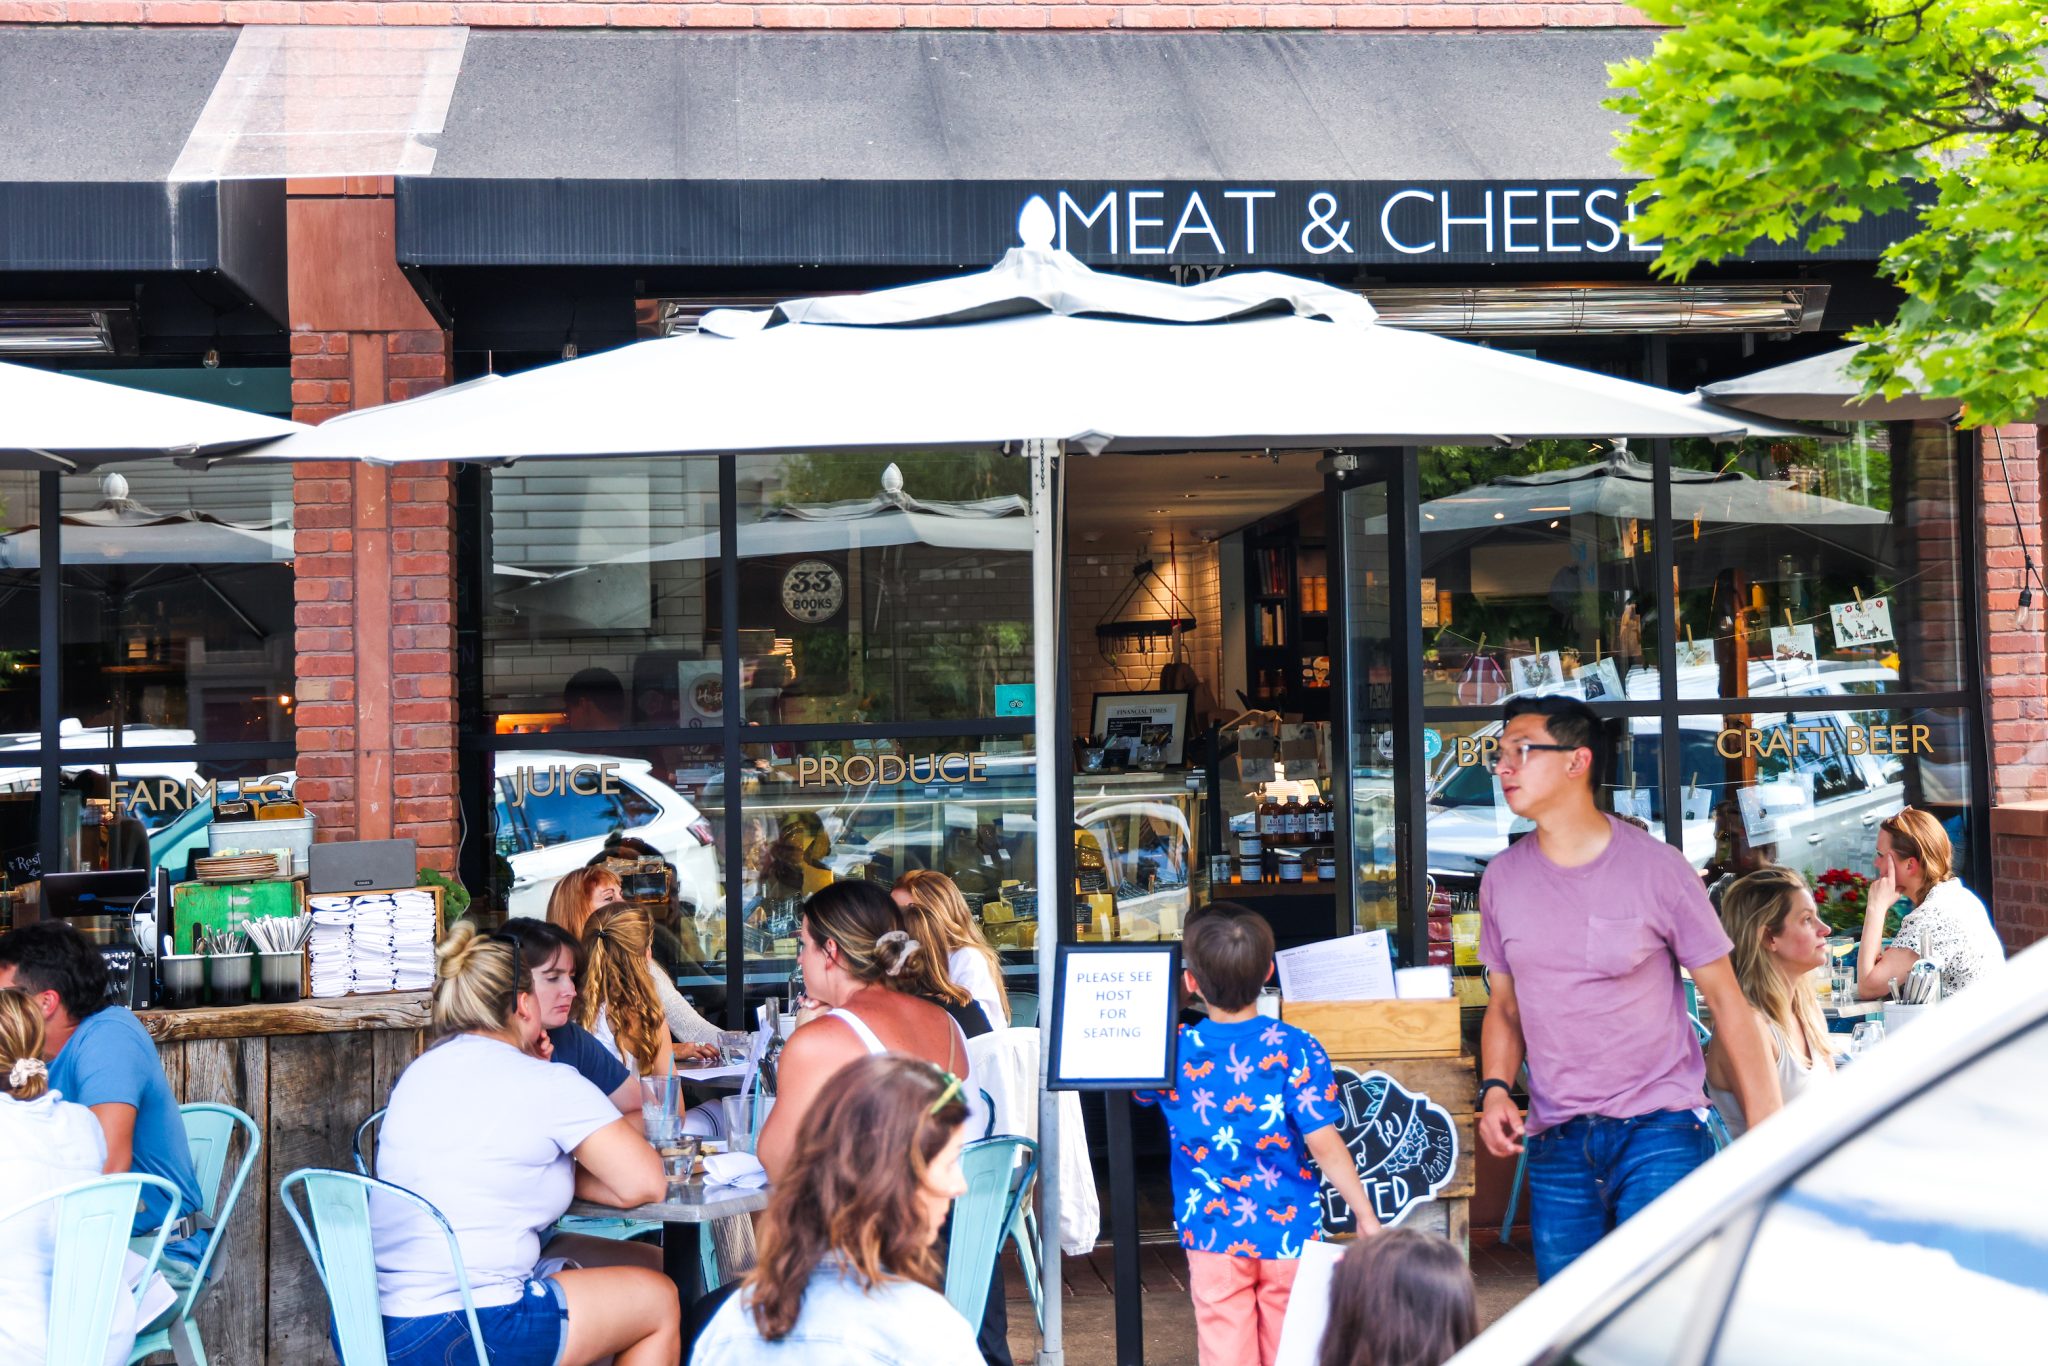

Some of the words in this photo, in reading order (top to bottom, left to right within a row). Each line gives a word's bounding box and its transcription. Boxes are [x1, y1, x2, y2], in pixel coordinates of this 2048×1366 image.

[1059, 190, 1276, 254] MEAT
[1301, 193, 1355, 254] &
[791, 571, 833, 592] 33
[793, 599, 832, 610] BOOKS
[1716, 726, 1835, 759] CRAFT
[1846, 724, 1935, 756] BEER
[512, 763, 621, 808] JUICE
[799, 752, 988, 788] PRODUCE
[110, 777, 218, 812] FARM
[1077, 971, 1125, 983] PLEASE
[1130, 971, 1153, 982] SEE
[1096, 990, 1132, 1001] HOST
[1100, 1008, 1127, 1019] FOR
[1084, 1026, 1141, 1038] SEATING
[1375, 1112, 1403, 1148] be
[1421, 1124, 1450, 1184] thanks!
